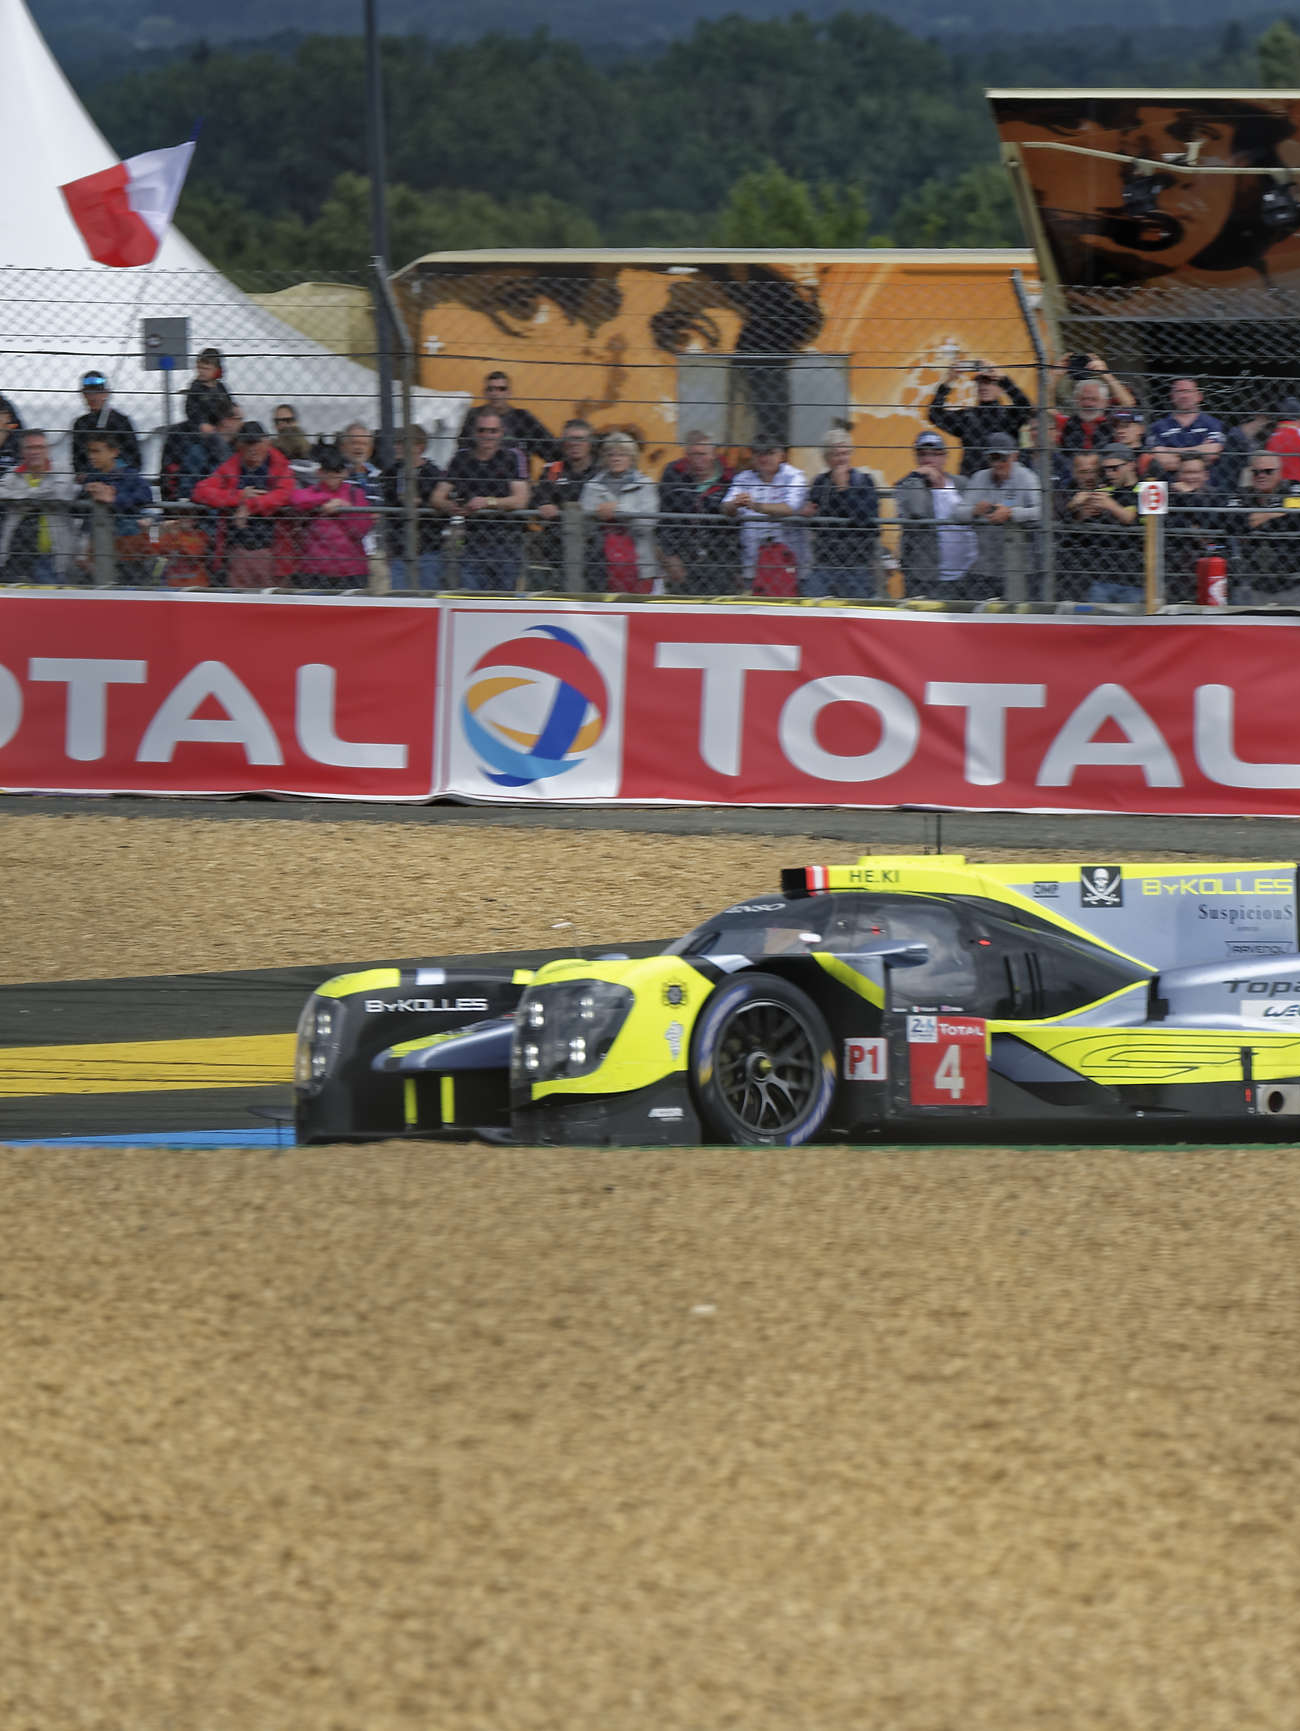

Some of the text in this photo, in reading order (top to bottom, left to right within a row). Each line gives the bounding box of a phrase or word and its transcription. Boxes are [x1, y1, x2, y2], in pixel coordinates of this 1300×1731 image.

[0, 656, 408, 770] TAL
[938, 1023, 985, 1036] TOTAL
[848, 1045, 879, 1075] P1
[933, 1044, 966, 1099] 4
